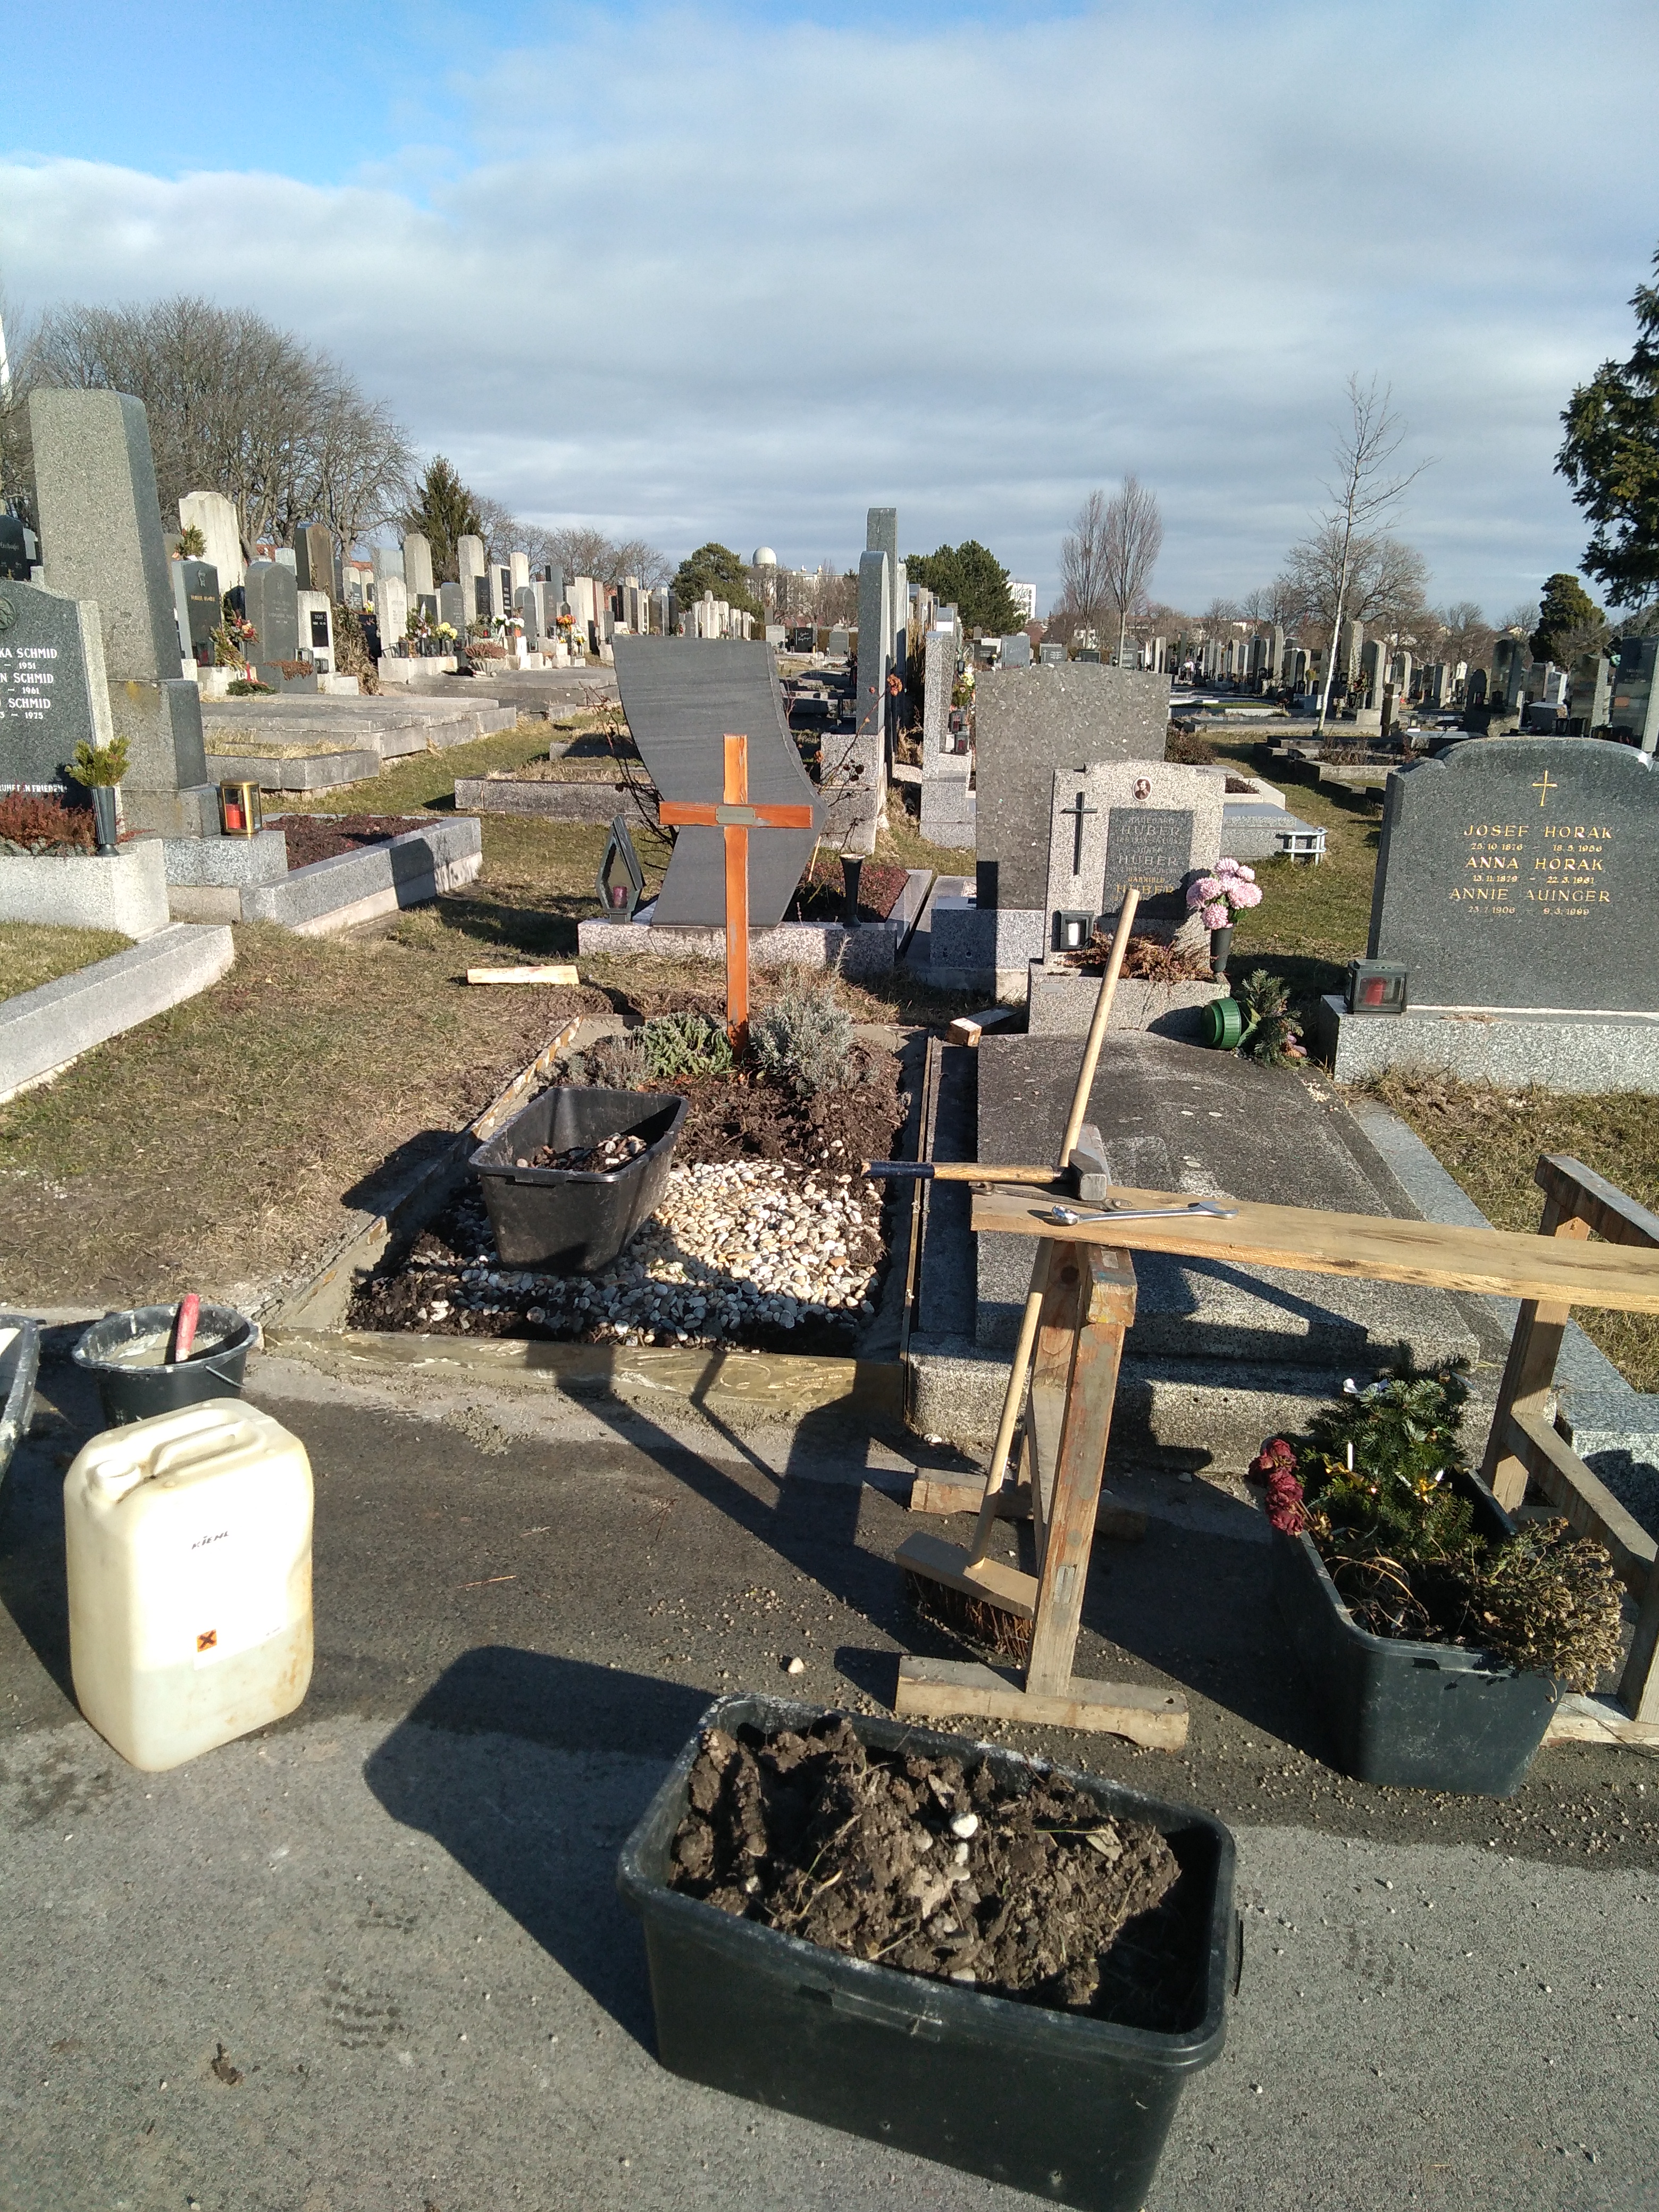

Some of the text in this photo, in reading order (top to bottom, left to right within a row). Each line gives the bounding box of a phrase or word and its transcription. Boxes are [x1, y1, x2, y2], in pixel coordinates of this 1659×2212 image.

[16, 648, 58, 659] SCHMID
[13, 672, 54, 684] SCHMID
[8, 697, 51, 709] SCHMID
[1121, 825, 1179, 836] HUBER
[1463, 825, 1613, 839] JOSEF HORAK
[1118, 854, 1178, 866] HUBER
[1464, 856, 1604, 871] ANNA HORAK
[1448, 887, 1611, 903] ANNIE AUINGER
